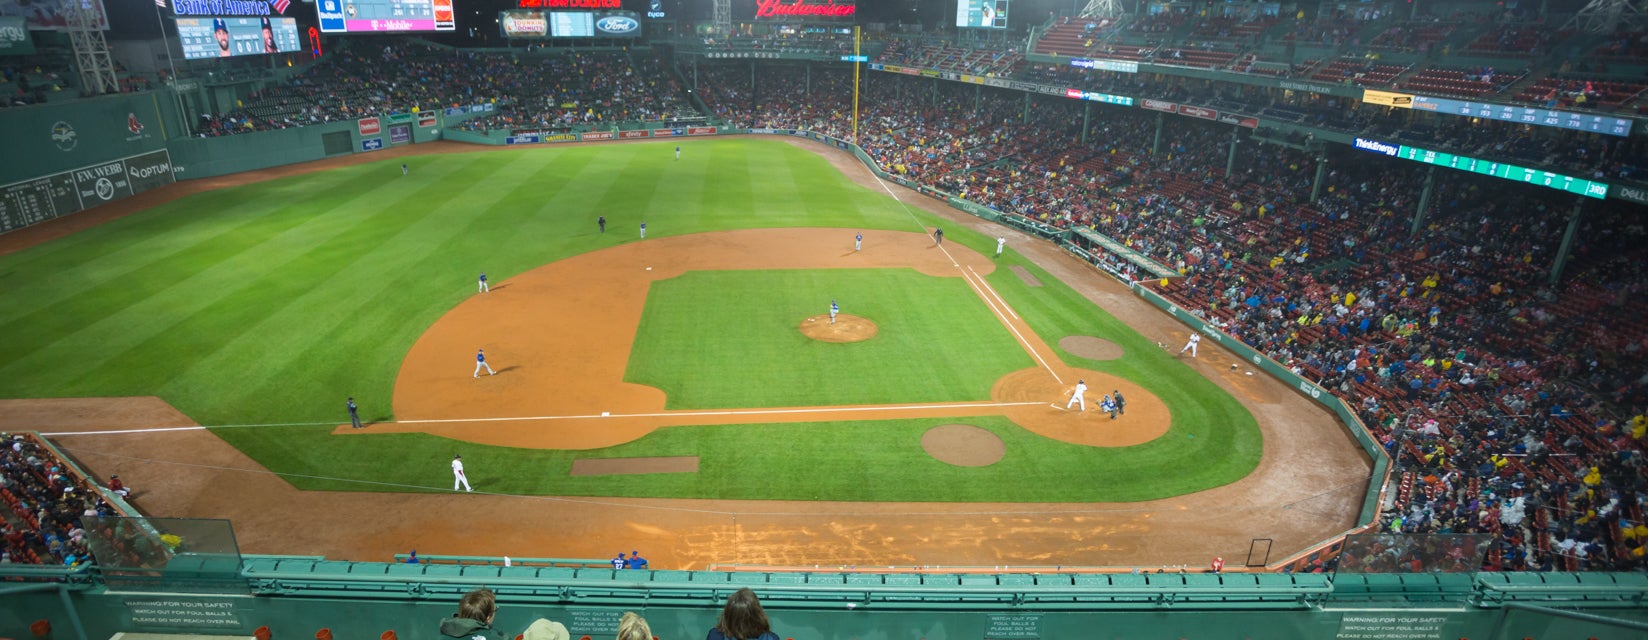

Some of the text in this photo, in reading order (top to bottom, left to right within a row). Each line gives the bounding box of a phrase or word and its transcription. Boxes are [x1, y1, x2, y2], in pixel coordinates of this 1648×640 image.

[174, 0, 270, 15] Bank of America
[756, 0, 855, 17] Budweiser
[604, 18, 630, 30] Ford
[1355, 138, 1397, 156] ThinkEnergy
[94, 163, 122, 177] WEBB
[140, 163, 169, 178] OPTUM
[1589, 184, 1606, 195] 3RD
